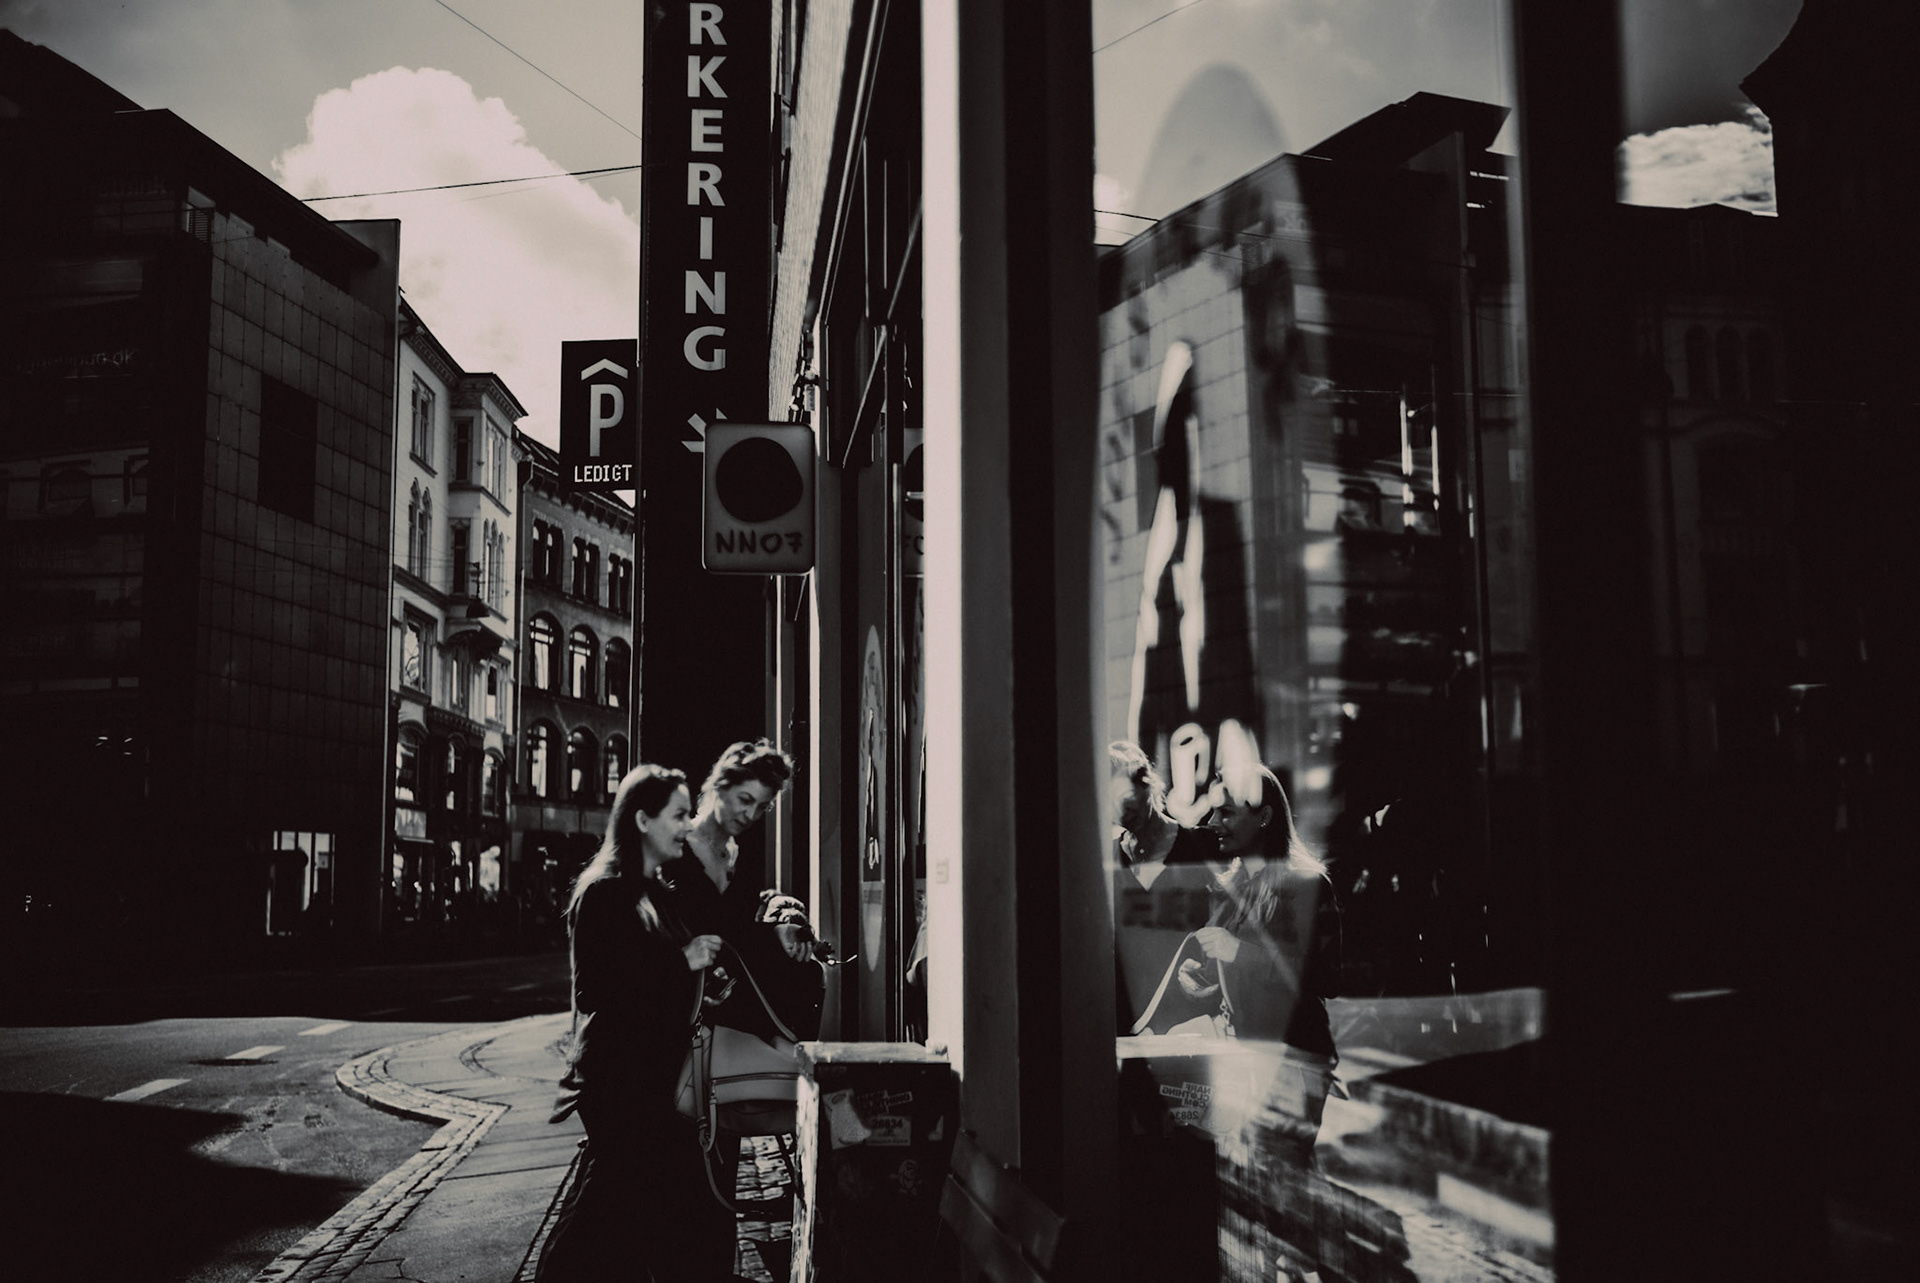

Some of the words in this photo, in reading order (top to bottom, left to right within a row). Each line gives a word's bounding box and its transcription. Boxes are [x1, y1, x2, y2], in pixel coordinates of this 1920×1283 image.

[683, 2, 729, 372] RKERING
[589, 384, 625, 457] P
[573, 464, 633, 483] LEDIGT
